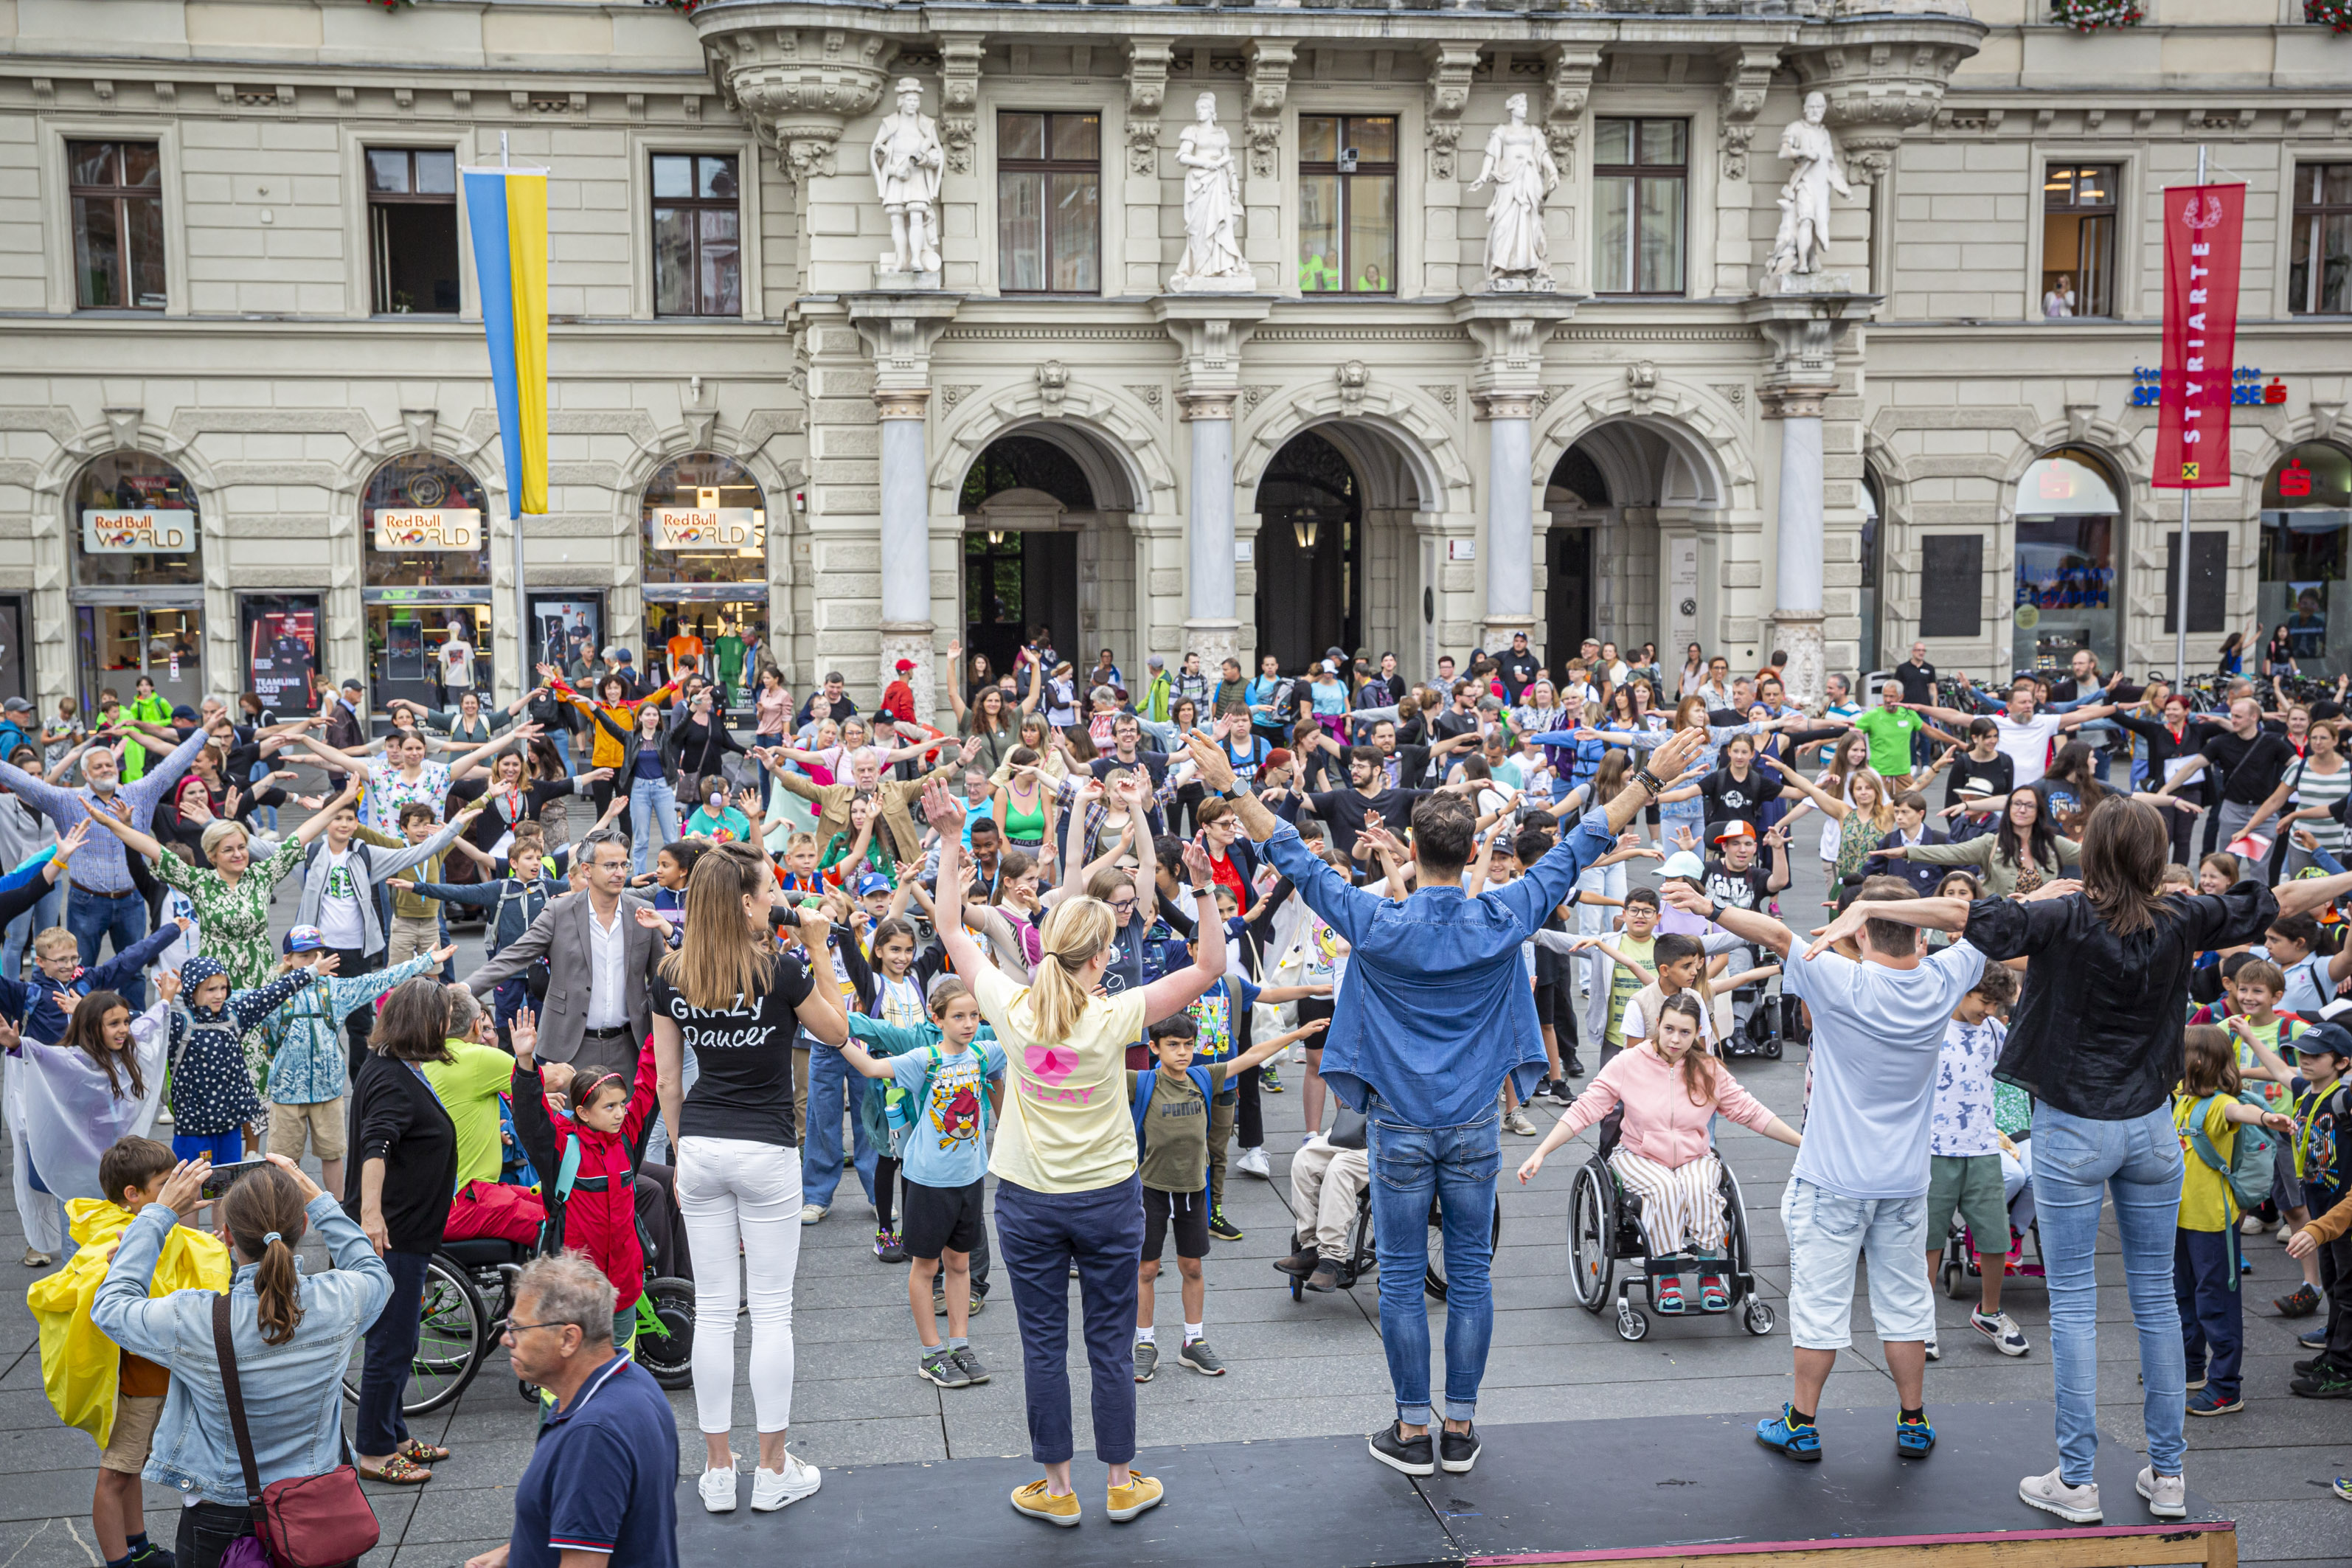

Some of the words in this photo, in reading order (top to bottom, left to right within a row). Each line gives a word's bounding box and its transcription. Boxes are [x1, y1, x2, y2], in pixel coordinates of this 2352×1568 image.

[2184, 242, 2210, 443] STYRIARTE
[95, 516, 122, 528] Red
[125, 516, 152, 528] Bull
[386, 515, 412, 527] Red
[415, 515, 440, 527] Bull
[665, 513, 689, 525] Red
[692, 513, 716, 525] Bull
[94, 529, 183, 547] WORLD
[386, 528, 470, 545] WORLD
[663, 527, 744, 543] WORLD
[2016, 588, 2109, 607] Exchange
[255, 678, 301, 686] TEAMLINE
[1493, 837, 1506, 845] YC
[683, 1025, 776, 1048] Dancer
[941, 1066, 954, 1079] DO
[956, 1064, 968, 1076] MY
[1021, 1076, 1096, 1104] PLAY
[1162, 1100, 1201, 1117] PUMA
